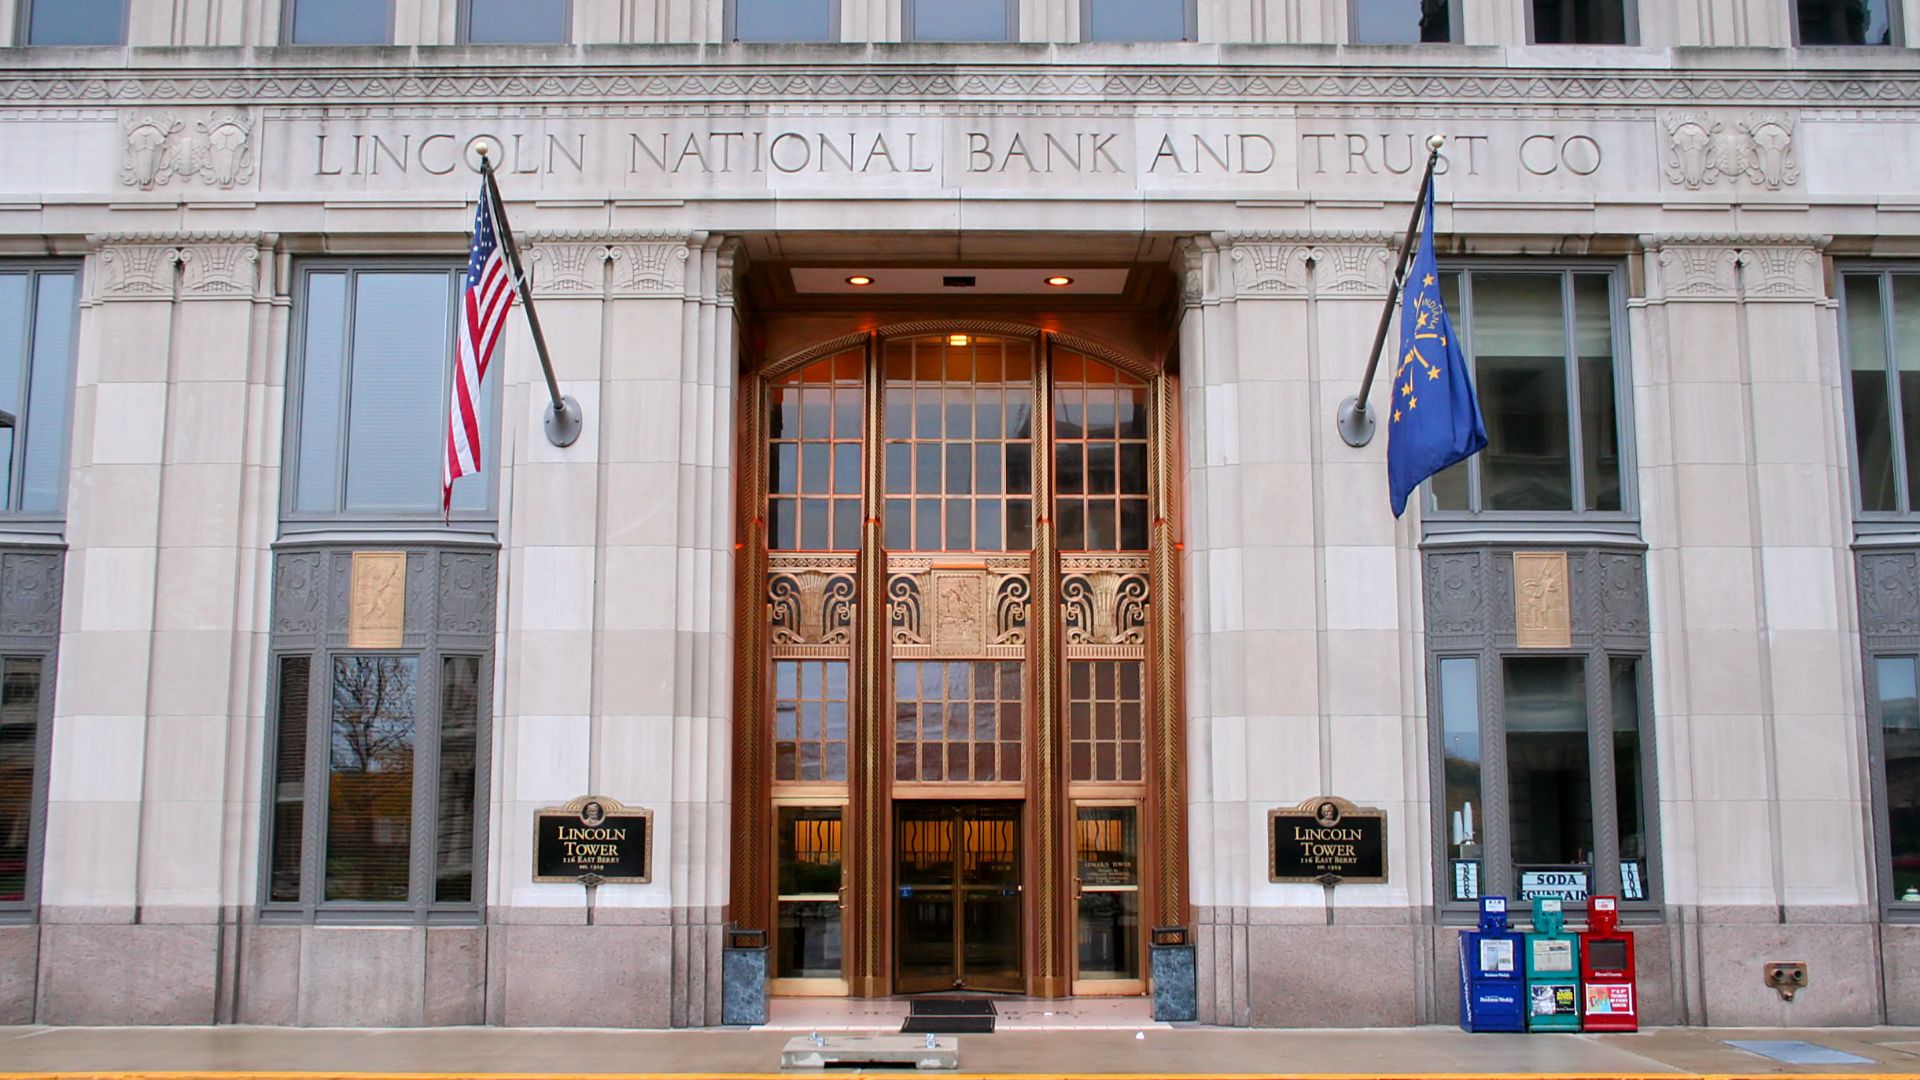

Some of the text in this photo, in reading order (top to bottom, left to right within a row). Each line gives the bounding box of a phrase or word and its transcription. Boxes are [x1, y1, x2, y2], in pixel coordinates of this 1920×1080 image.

[316, 131, 1603, 176] LINCOLN NATIONAL BANK AND TRUST CO
[1422, 298, 1439, 329] INDIANA
[558, 826, 626, 840] LINCOLN
[1294, 826, 1362, 840] LINCOLN
[563, 841, 619, 856] TOWER
[1300, 842, 1356, 856] TOWER
[577, 856, 596, 864] EAST
[597, 856, 620, 864] BERRY
[1315, 856, 1333, 864] EAST
[1334, 856, 1358, 864] BERRY
[1537, 874, 1577, 886] SODA
